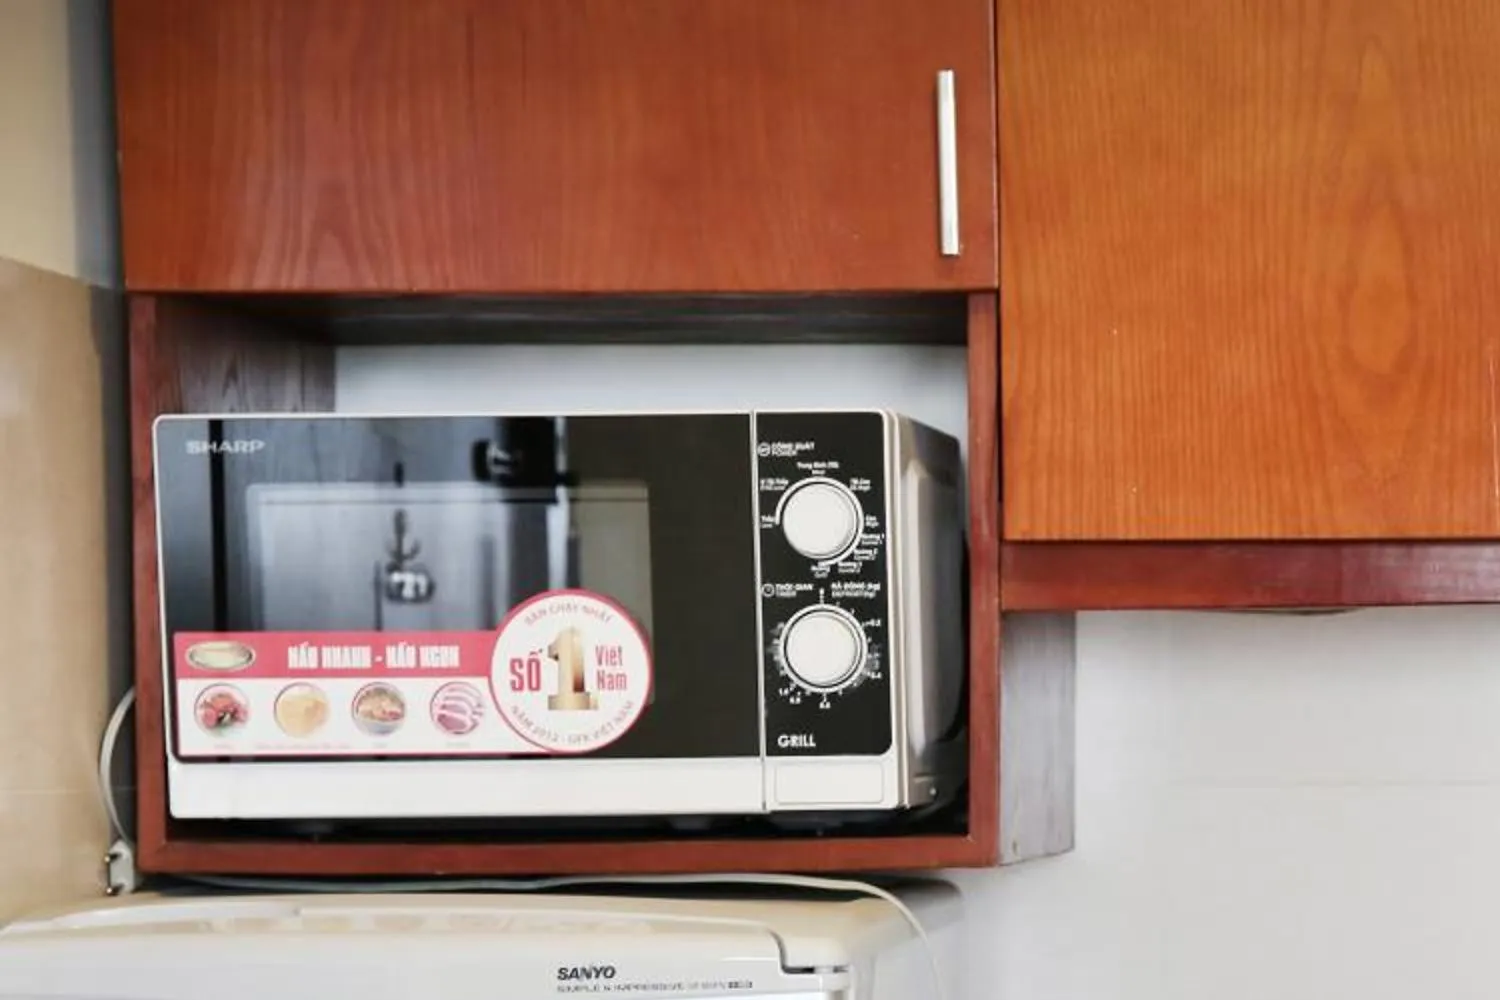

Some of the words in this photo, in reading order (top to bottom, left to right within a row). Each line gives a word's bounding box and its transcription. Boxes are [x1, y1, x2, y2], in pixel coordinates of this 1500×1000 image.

[185, 440, 266, 454] SHARP
[509, 648, 544, 692] SỐ
[547, 626, 599, 711] 1
[596, 670, 627, 691] Nam
[777, 735, 816, 747] GRILL
[557, 966, 616, 981] SANYO
